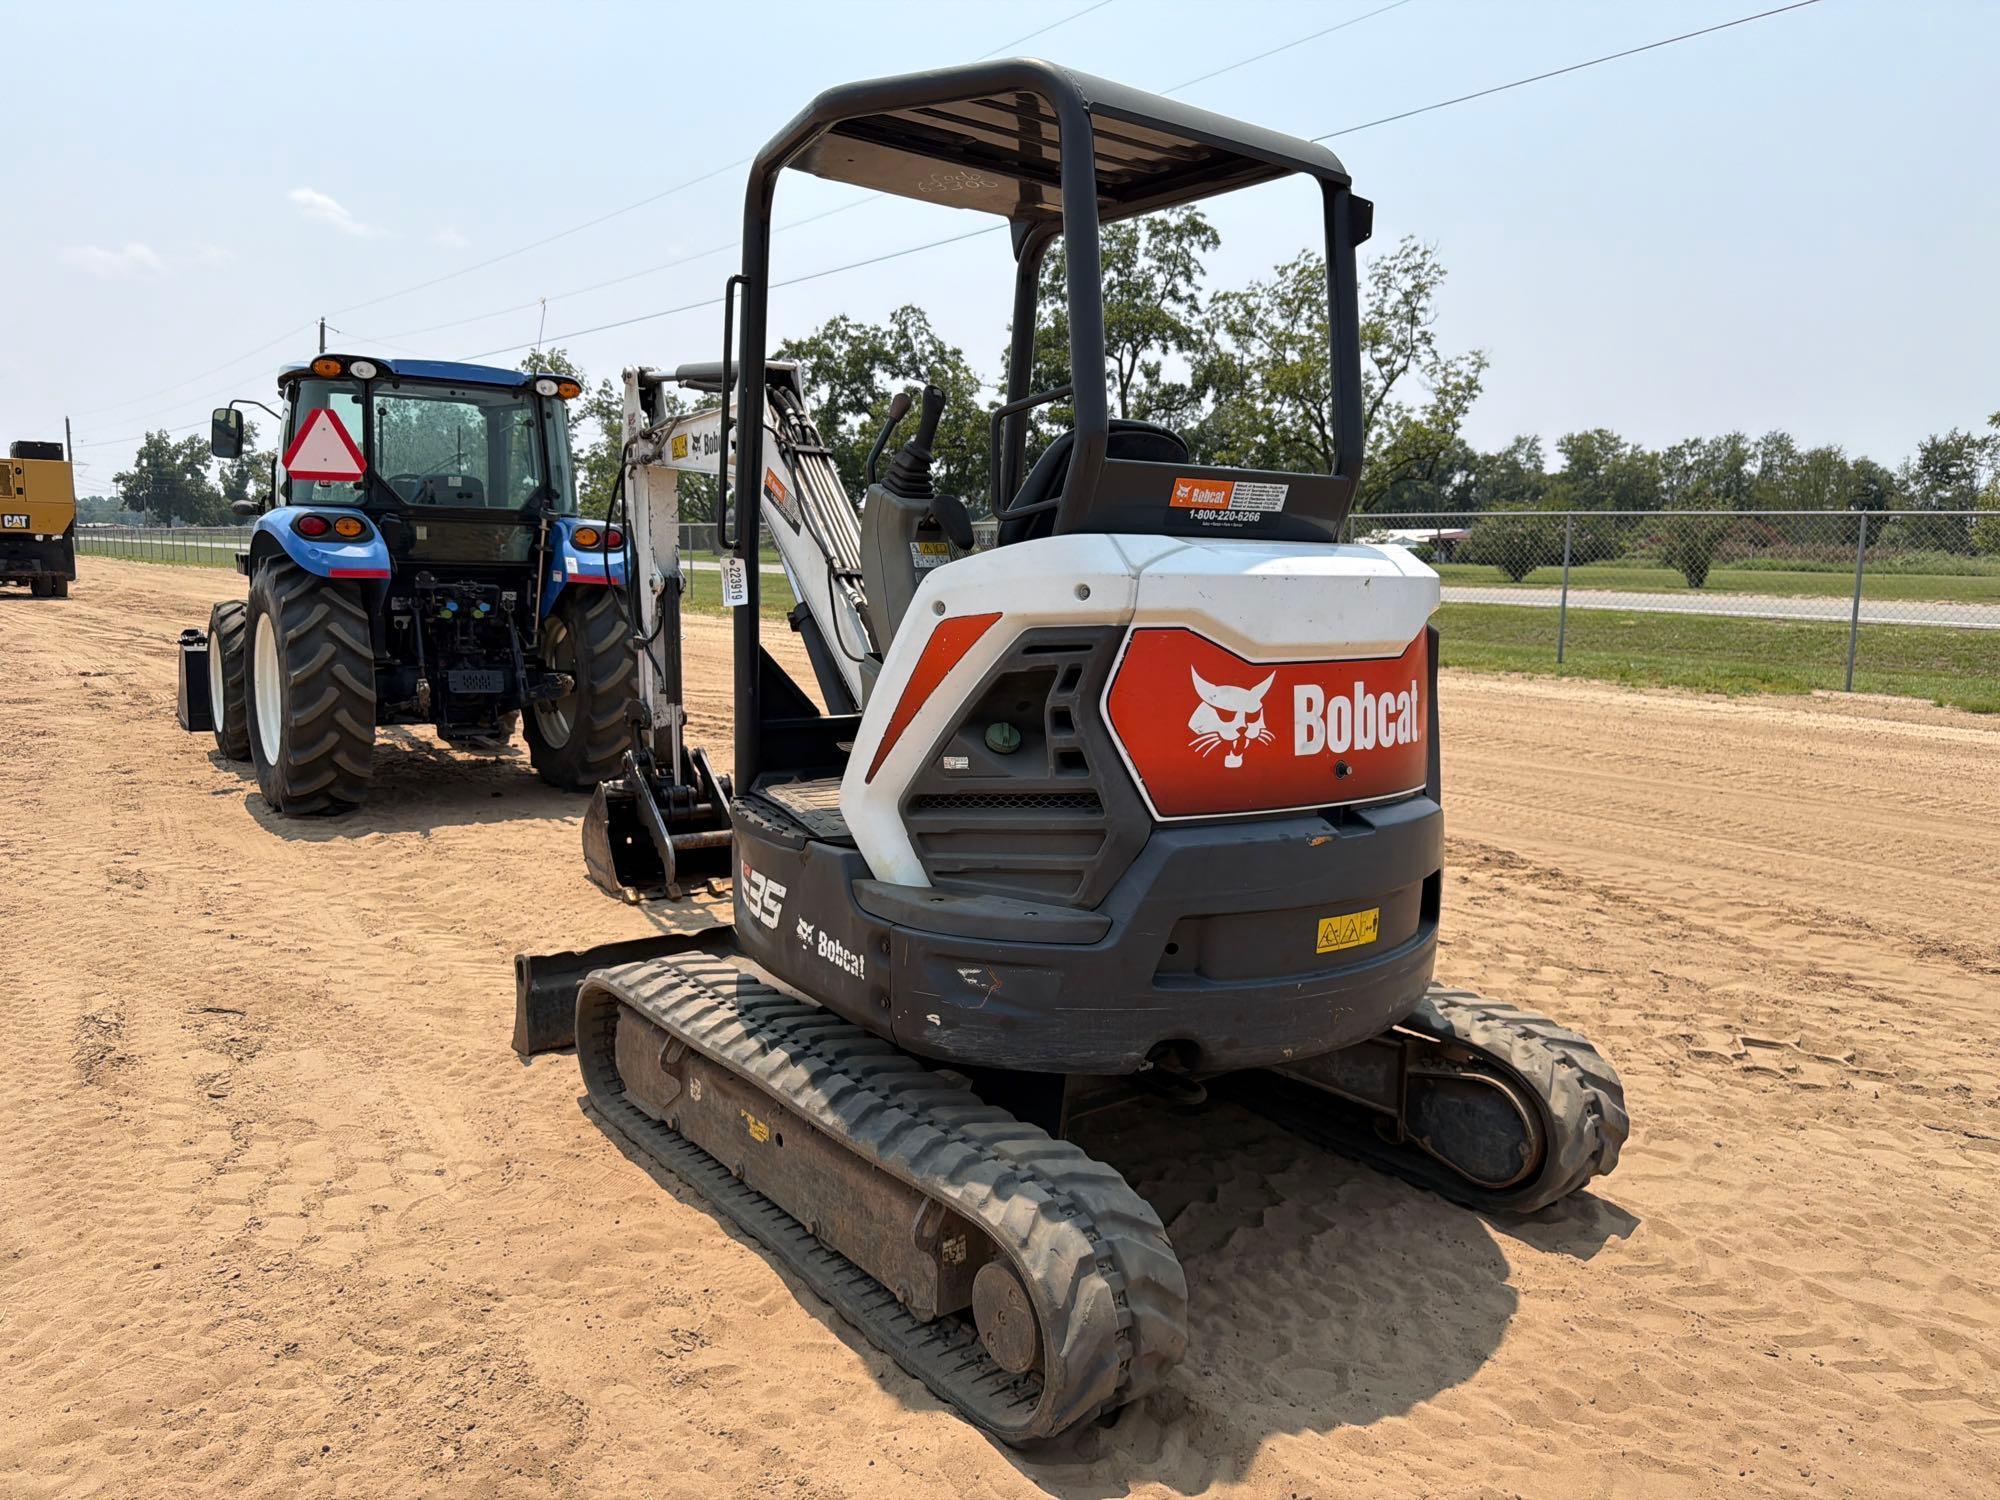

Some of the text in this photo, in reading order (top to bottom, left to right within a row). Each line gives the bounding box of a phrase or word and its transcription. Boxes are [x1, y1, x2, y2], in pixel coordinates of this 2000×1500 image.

[703, 431, 721, 456] Bob
[1191, 488, 1225, 504] Bobcat
[4, 515, 27, 527] CAT
[1189, 509, 1261, 522] 1-800-220-6266
[729, 567, 743, 600] 223919
[1293, 680, 1419, 756] Bobcat
[741, 859, 787, 930] E35
[819, 931, 865, 980] Bobcat
